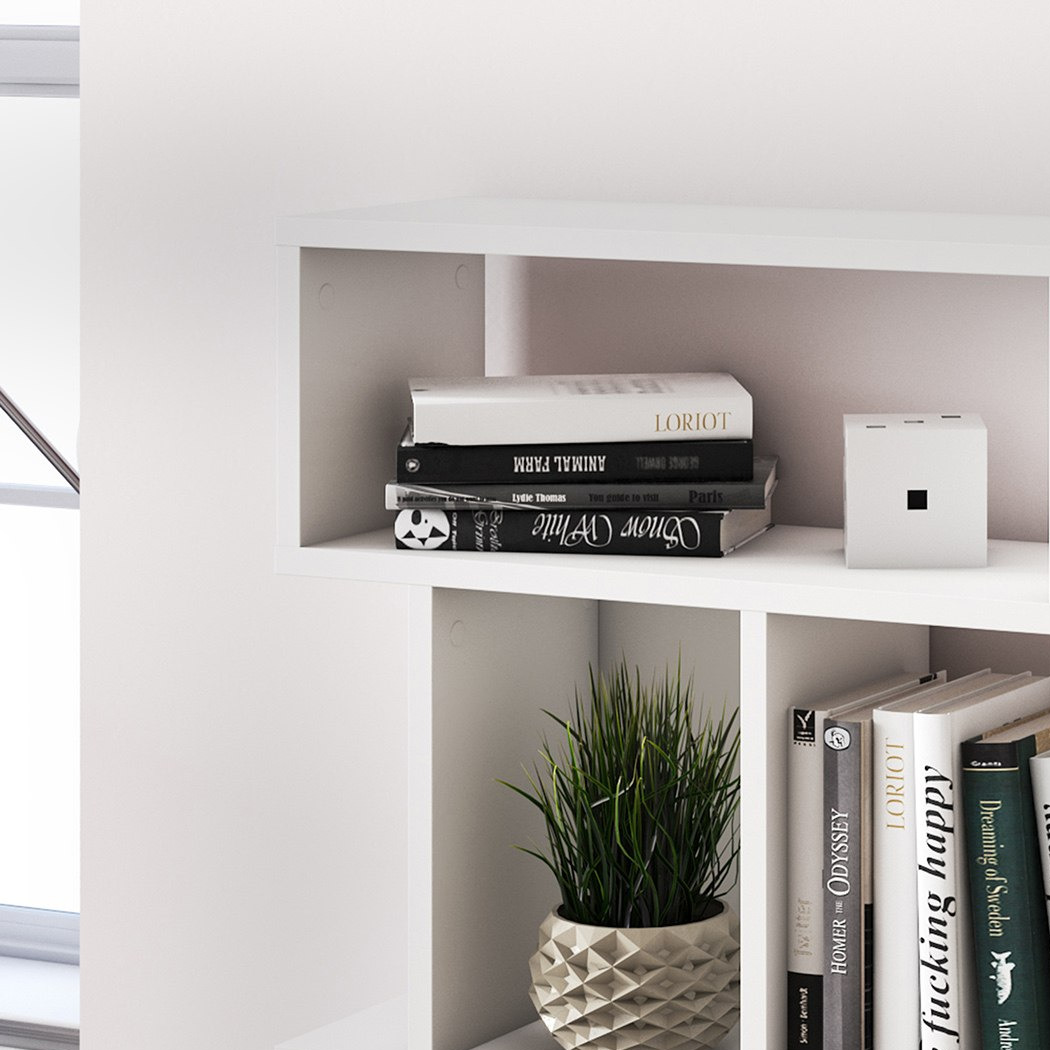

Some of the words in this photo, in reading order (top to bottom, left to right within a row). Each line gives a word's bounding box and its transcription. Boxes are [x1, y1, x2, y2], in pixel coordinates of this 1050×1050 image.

[655, 412, 731, 432] LORIOT
[513, 456, 550, 473] FARM
[552, 455, 606, 472] ANIMAL
[512, 493, 533, 503] Lydie
[536, 493, 567, 503] Thomas
[632, 493, 641, 503] to
[688, 490, 725, 503] Paris
[532, 512, 612, 547] White
[620, 515, 700, 549] Snow
[886, 737, 905, 830] LORIOT
[918, 765, 954, 879] happy
[976, 800, 1005, 866] Dreaming
[827, 808, 850, 896] ODYSSEY
[985, 868, 1008, 883] of
[835, 901, 843, 913] THE
[986, 885, 1011, 937] Sweden
[830, 919, 847, 974] HOMER
[920, 891, 960, 1043] fucking
